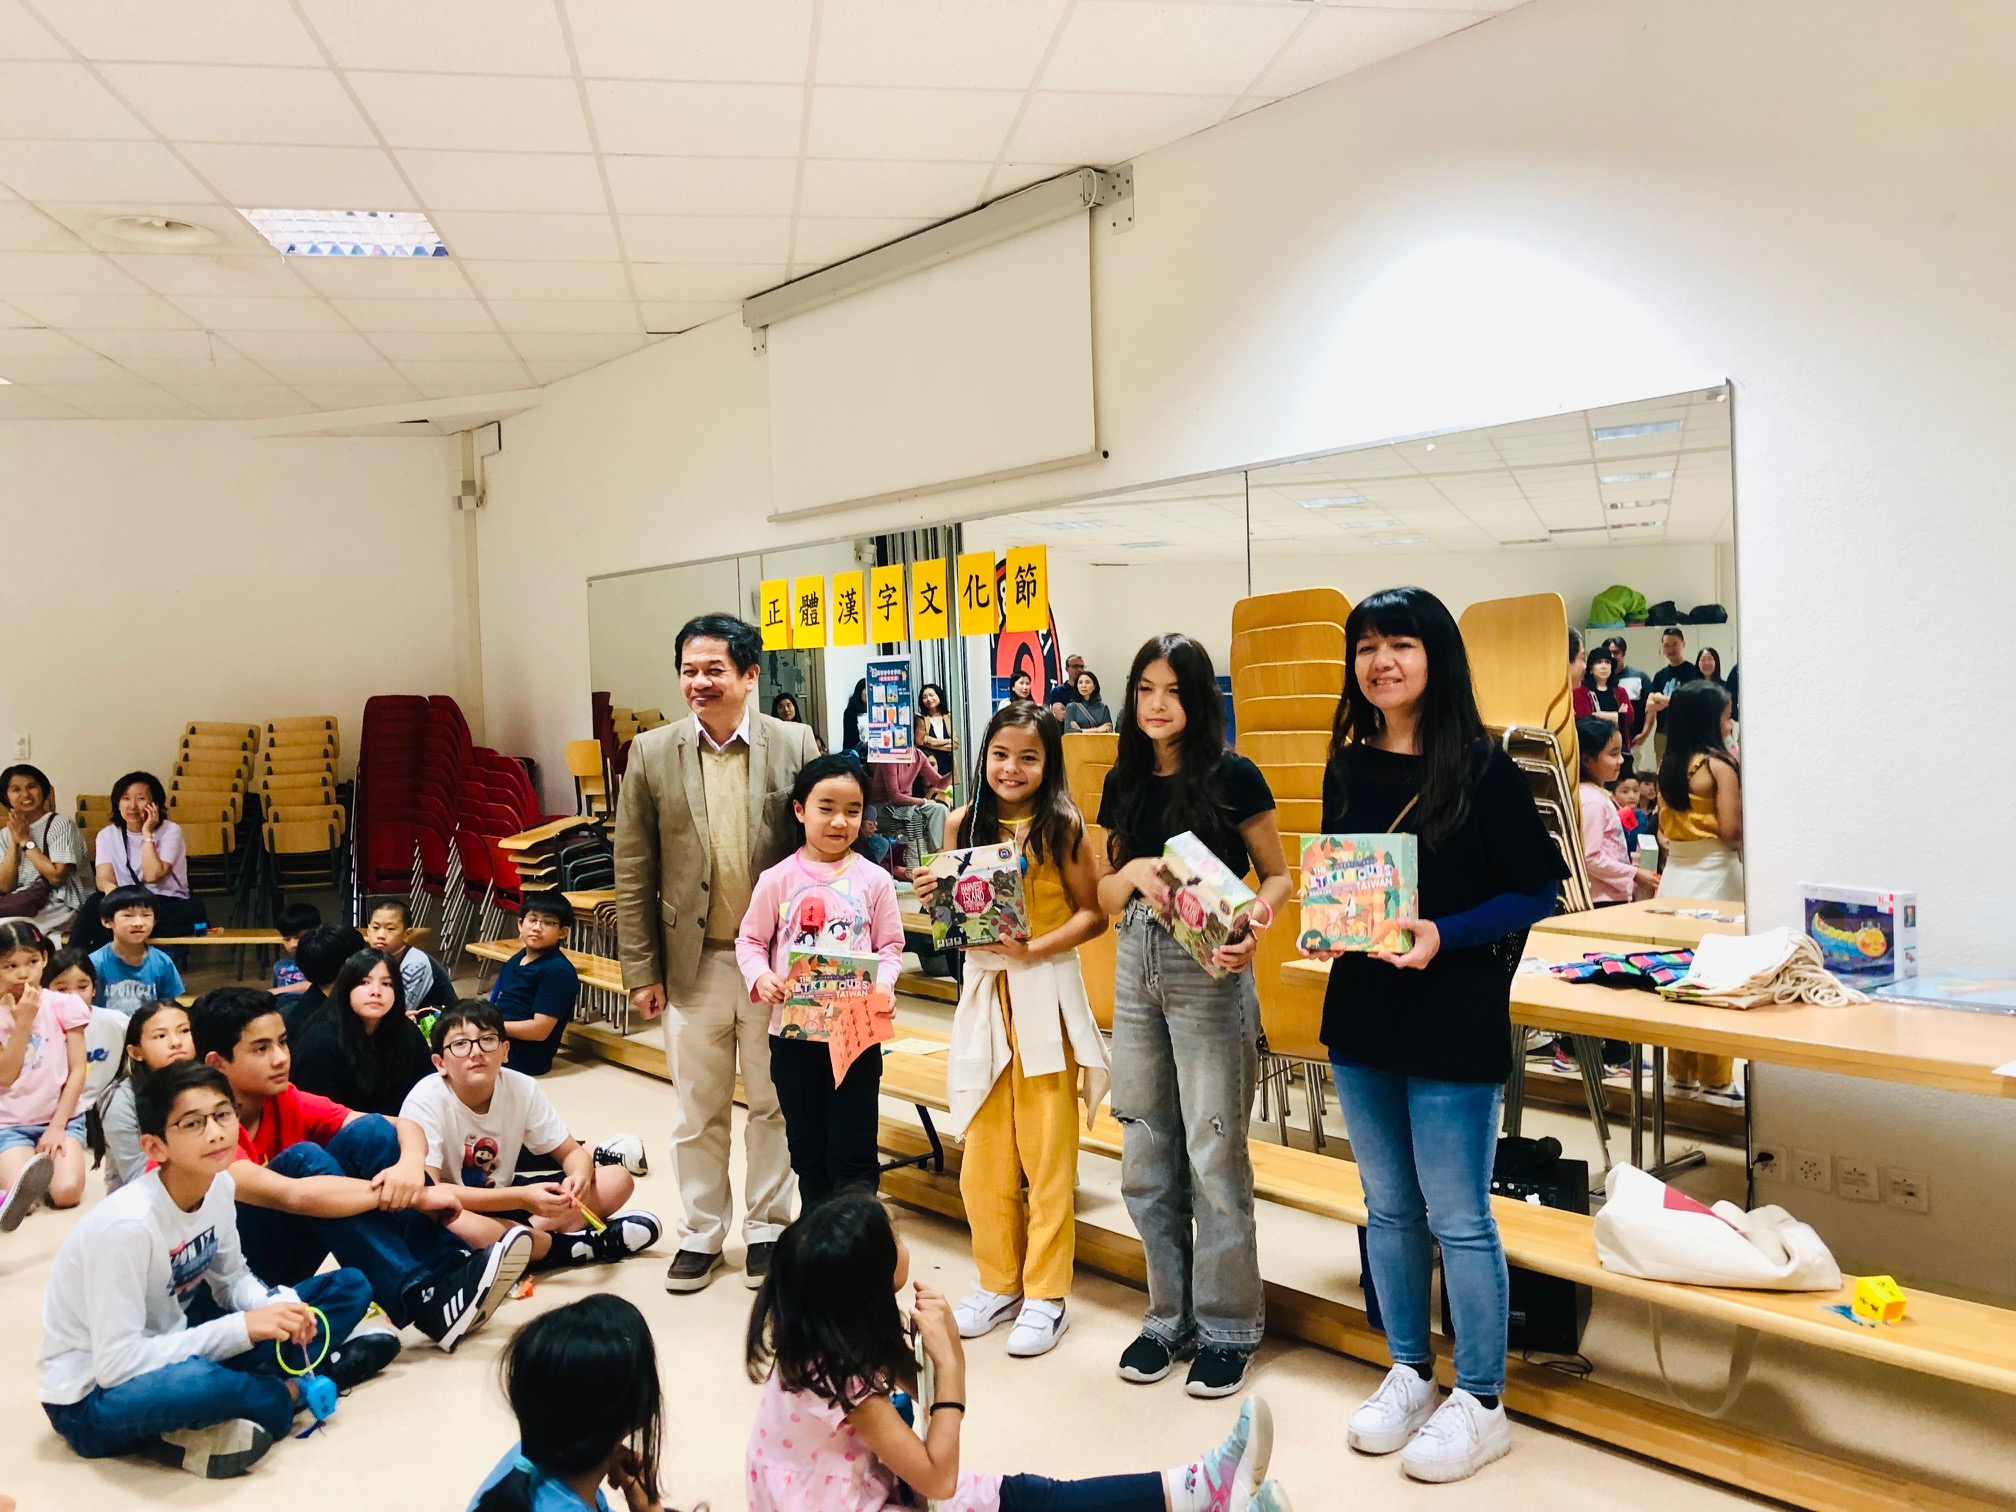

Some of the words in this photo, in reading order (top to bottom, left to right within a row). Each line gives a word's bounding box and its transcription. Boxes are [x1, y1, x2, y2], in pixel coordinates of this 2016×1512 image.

[765, 563, 1037, 628] 正體漢字文化節
[960, 881, 983, 893] HARVEST
[1356, 877, 1393, 891] TAIWAN
[961, 891, 985, 903] ISLAND
[835, 989, 868, 998] TAIWAN
